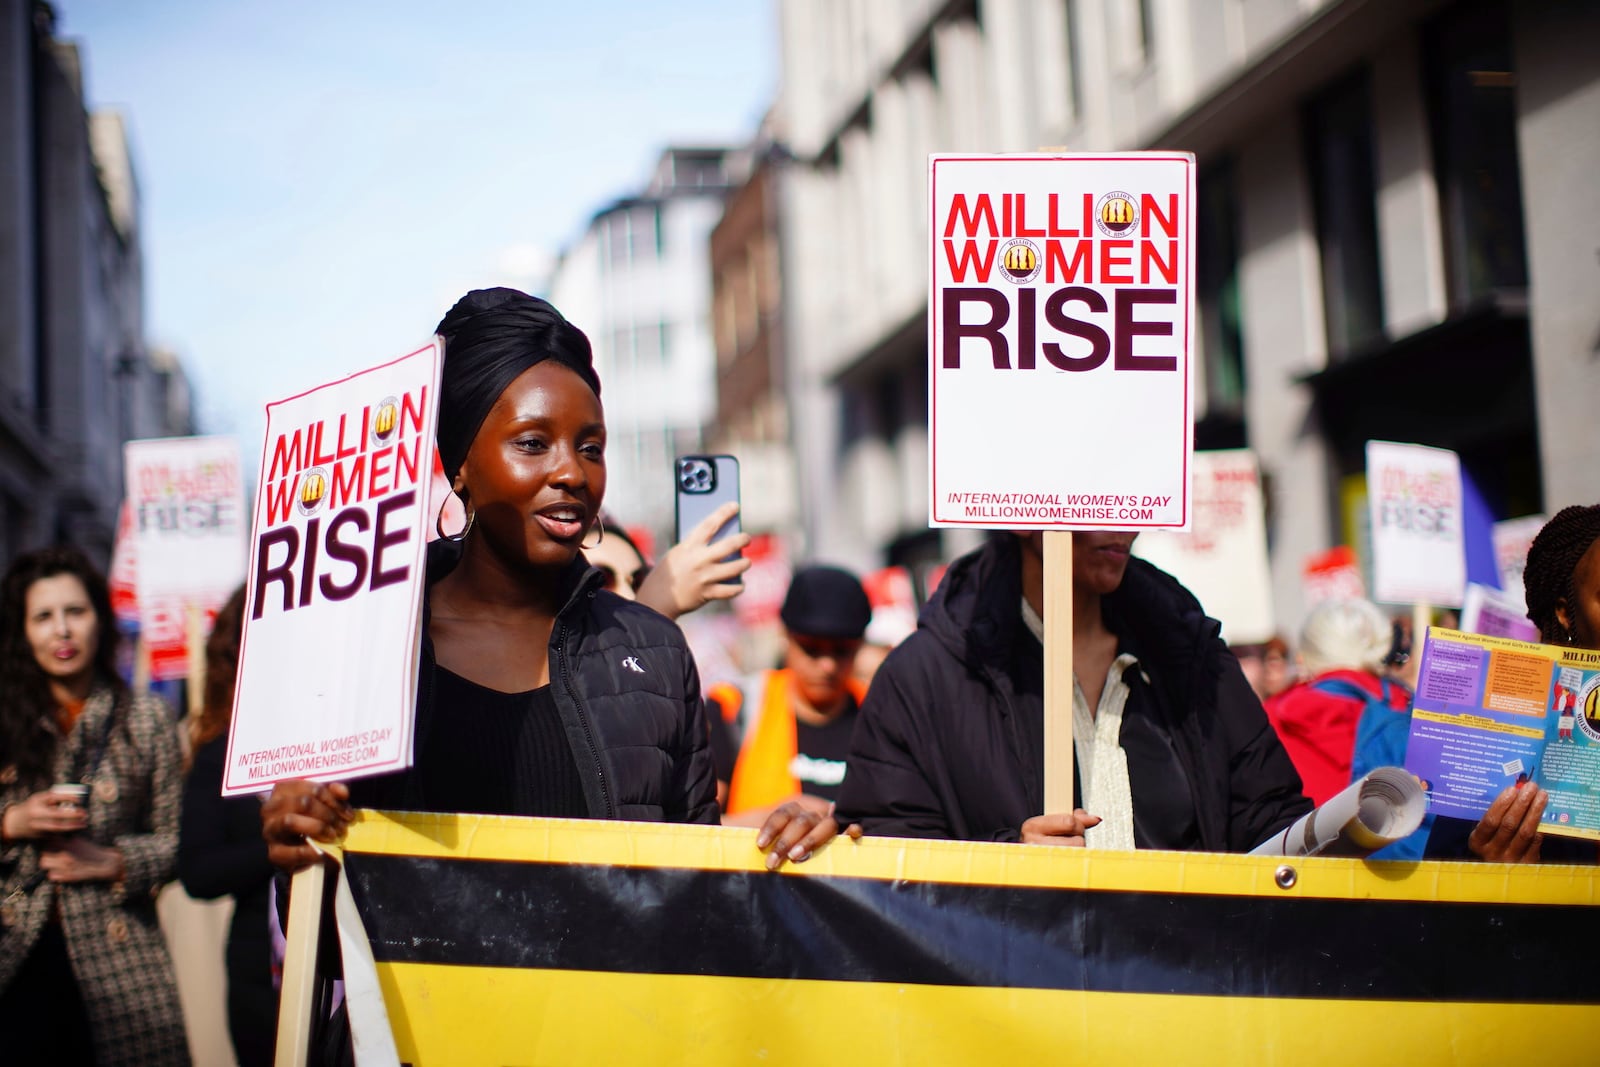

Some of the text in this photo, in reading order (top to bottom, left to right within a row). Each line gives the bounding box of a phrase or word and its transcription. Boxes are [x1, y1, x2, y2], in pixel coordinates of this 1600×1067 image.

[944, 191, 1178, 238] MILLION
[943, 238, 1178, 284] WOMEN
[943, 286, 1177, 372] RISE
[267, 385, 428, 482] MILLION
[267, 435, 422, 527] WOMEN
[948, 493, 1171, 507] INTERNATIONAL WOMEN'S DAY
[965, 506, 1153, 520] MILLIONWOMENRISE.COM
[253, 489, 416, 620] RISE
[239, 743, 315, 767] INTERNATIONAL
[370, 728, 392, 743] DAY
[249, 746, 378, 779] MILLIONWOMENRISE.COM
